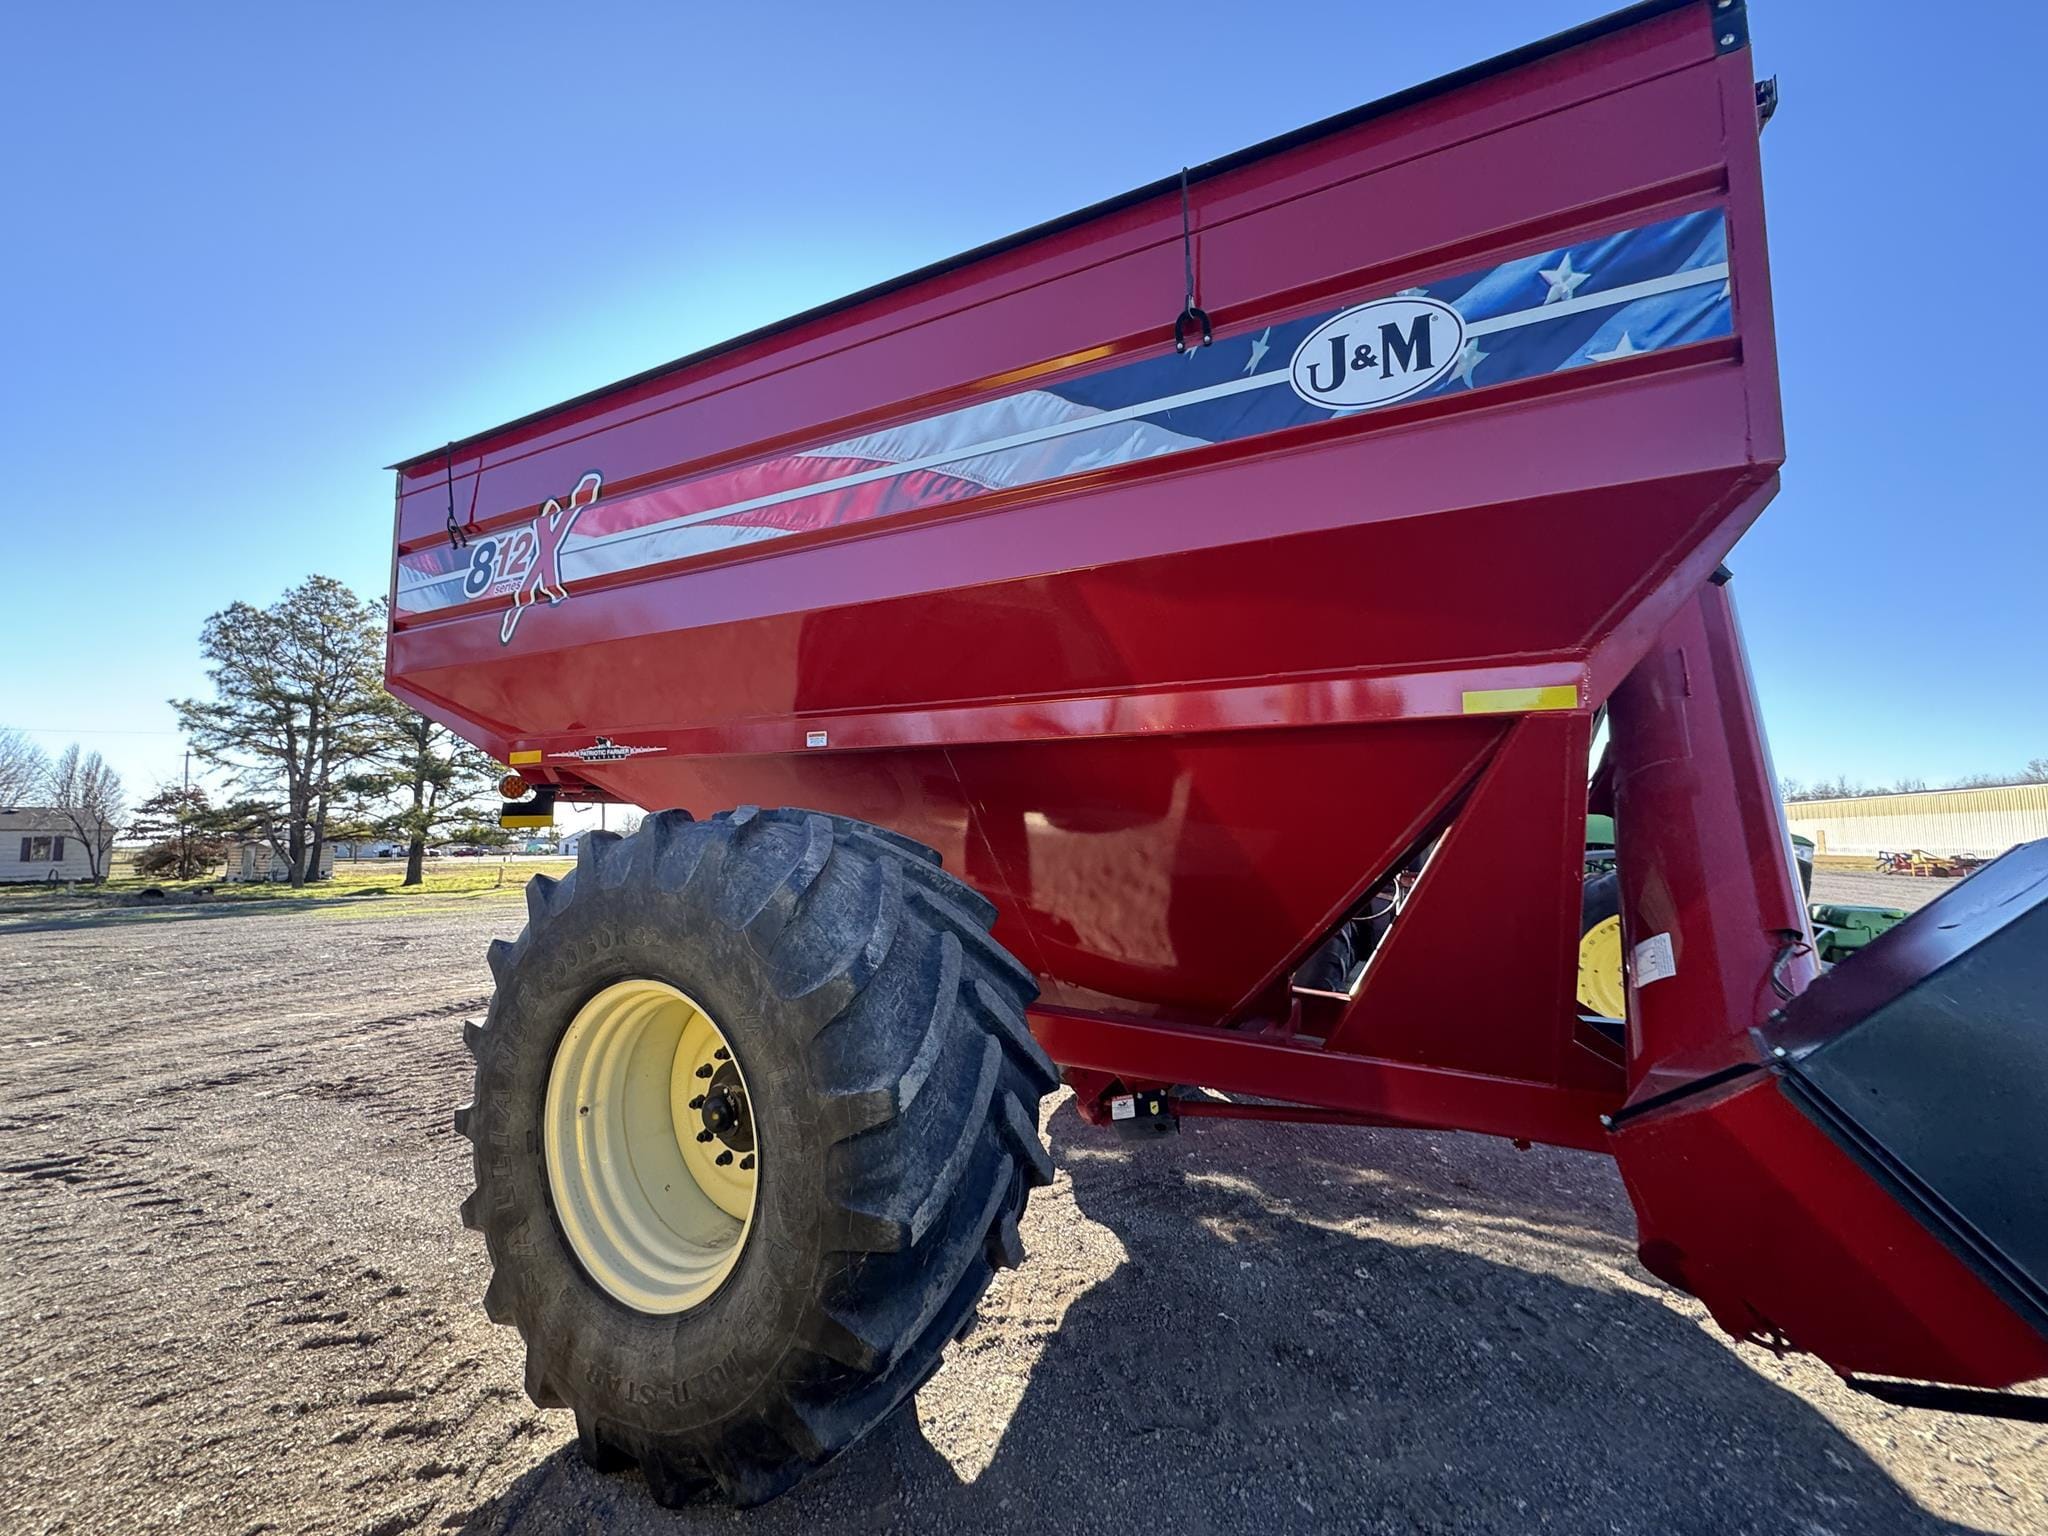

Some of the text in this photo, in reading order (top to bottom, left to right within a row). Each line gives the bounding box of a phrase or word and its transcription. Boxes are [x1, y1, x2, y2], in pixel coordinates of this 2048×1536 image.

[1306, 312, 1436, 393] J&M
[495, 580, 522, 594] series
[489, 982, 540, 1258] ALLIANCE
